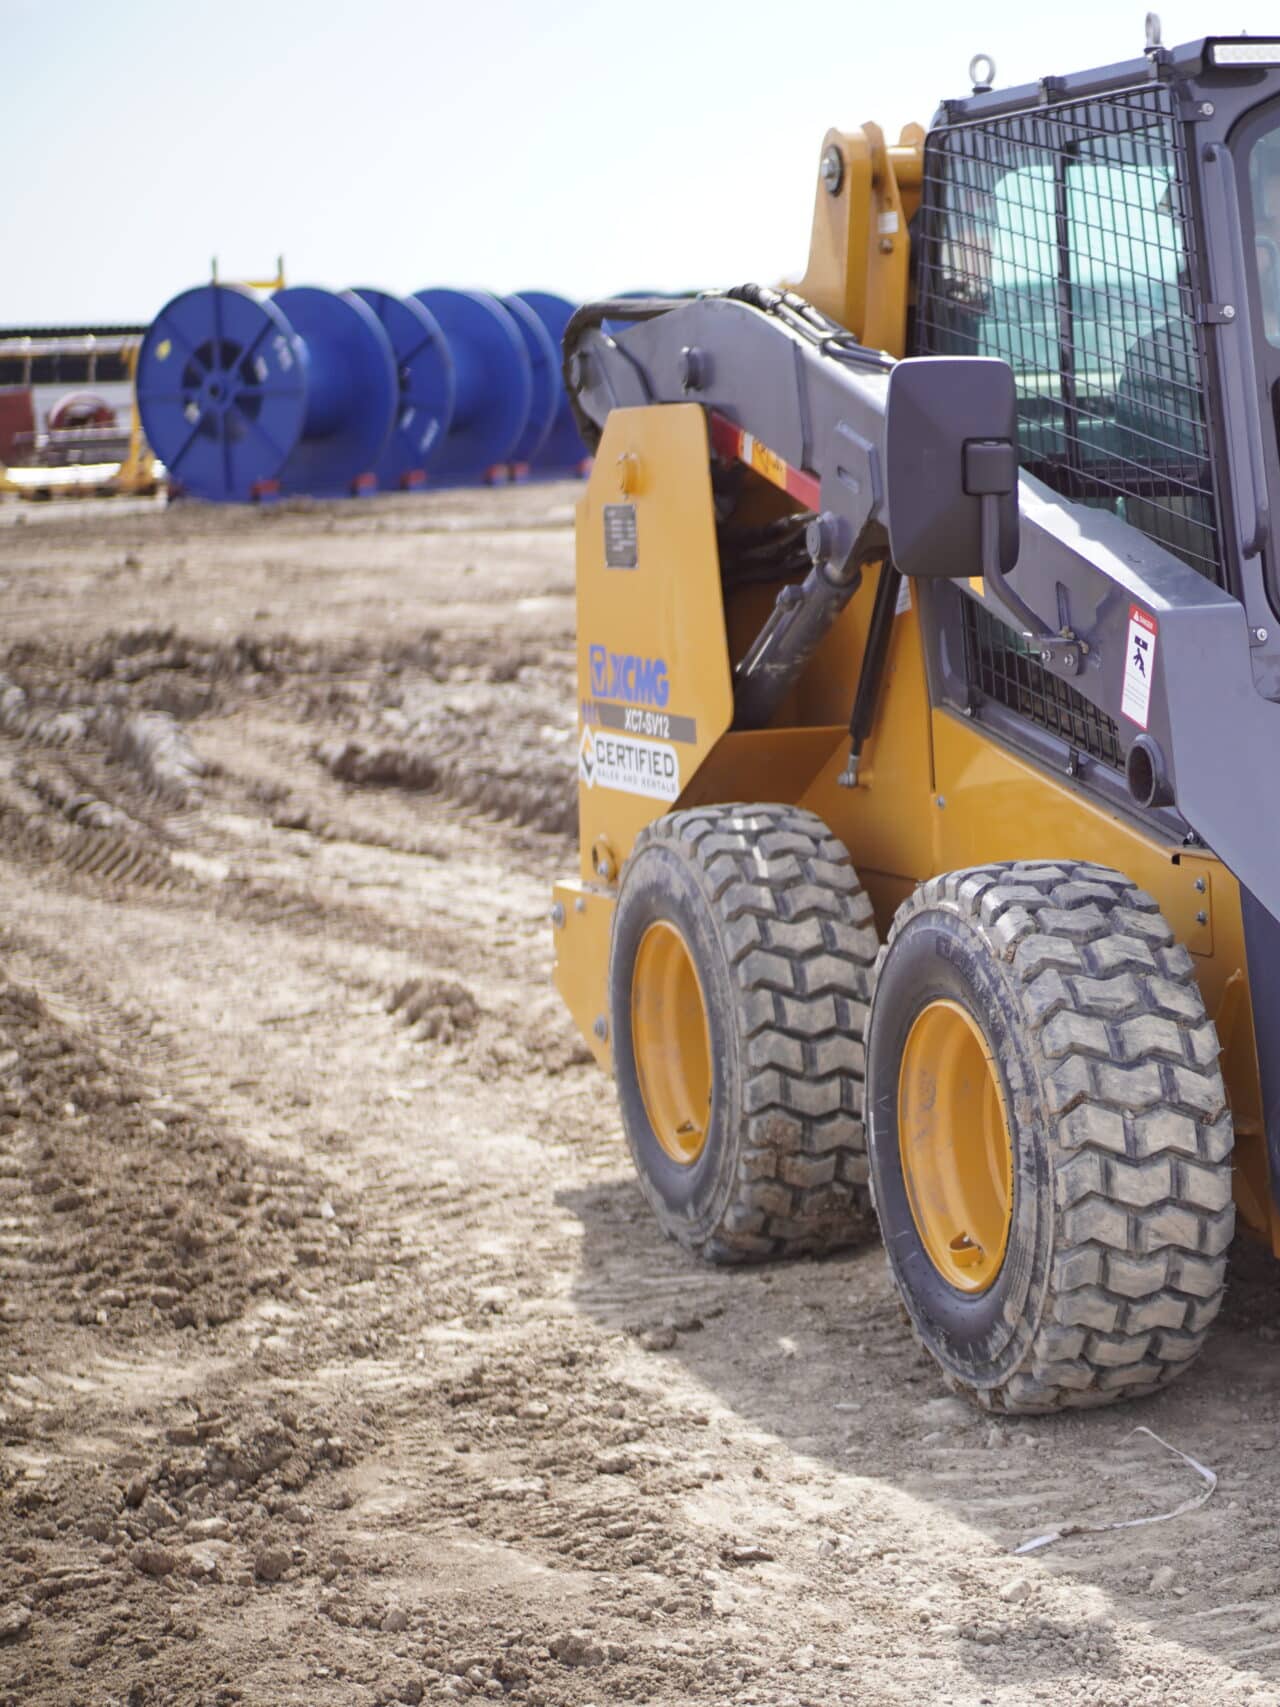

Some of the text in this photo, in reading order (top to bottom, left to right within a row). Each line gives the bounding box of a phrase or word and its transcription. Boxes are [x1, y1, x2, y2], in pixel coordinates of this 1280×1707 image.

[610, 654, 669, 707] XCMG
[625, 708, 670, 738] XC7-SV12
[596, 740, 674, 777] CERTIFIED
